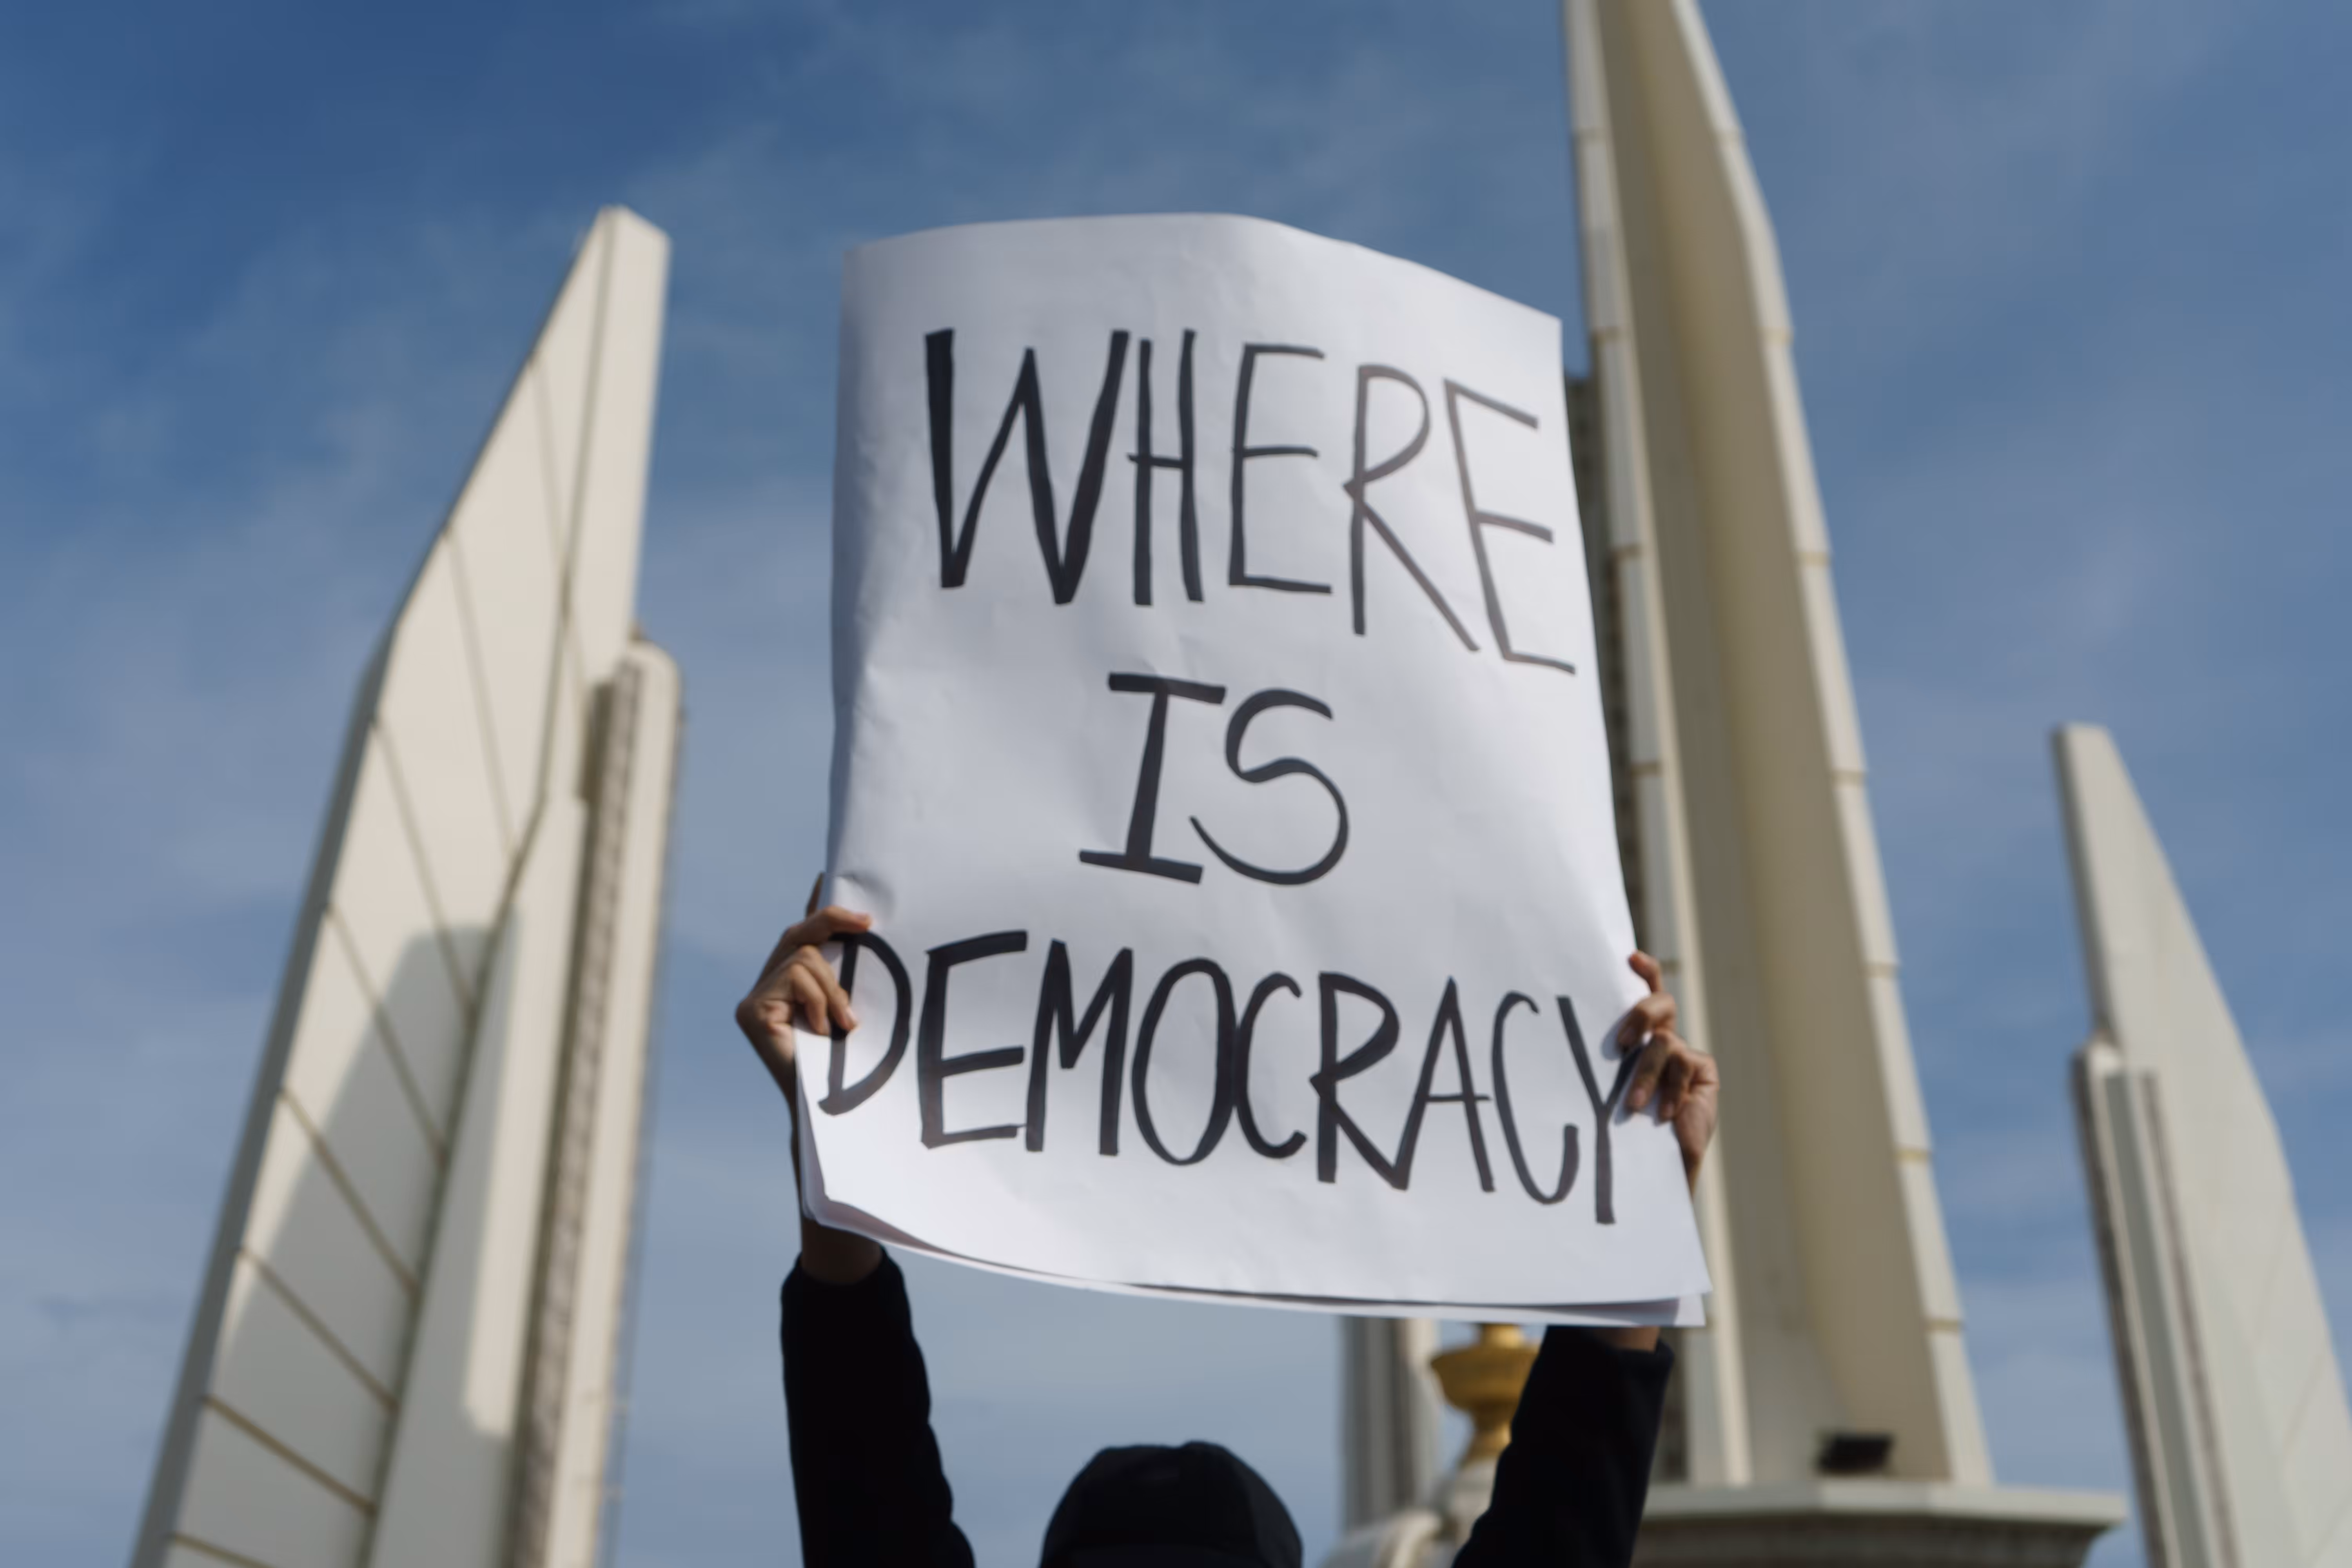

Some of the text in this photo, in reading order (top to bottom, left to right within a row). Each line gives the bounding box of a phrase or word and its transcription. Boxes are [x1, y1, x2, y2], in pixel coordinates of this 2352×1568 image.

[925, 328, 1576, 675] WHERE
[1079, 672, 1348, 886] IS
[818, 929, 1646, 1225] DEMOCRACY
